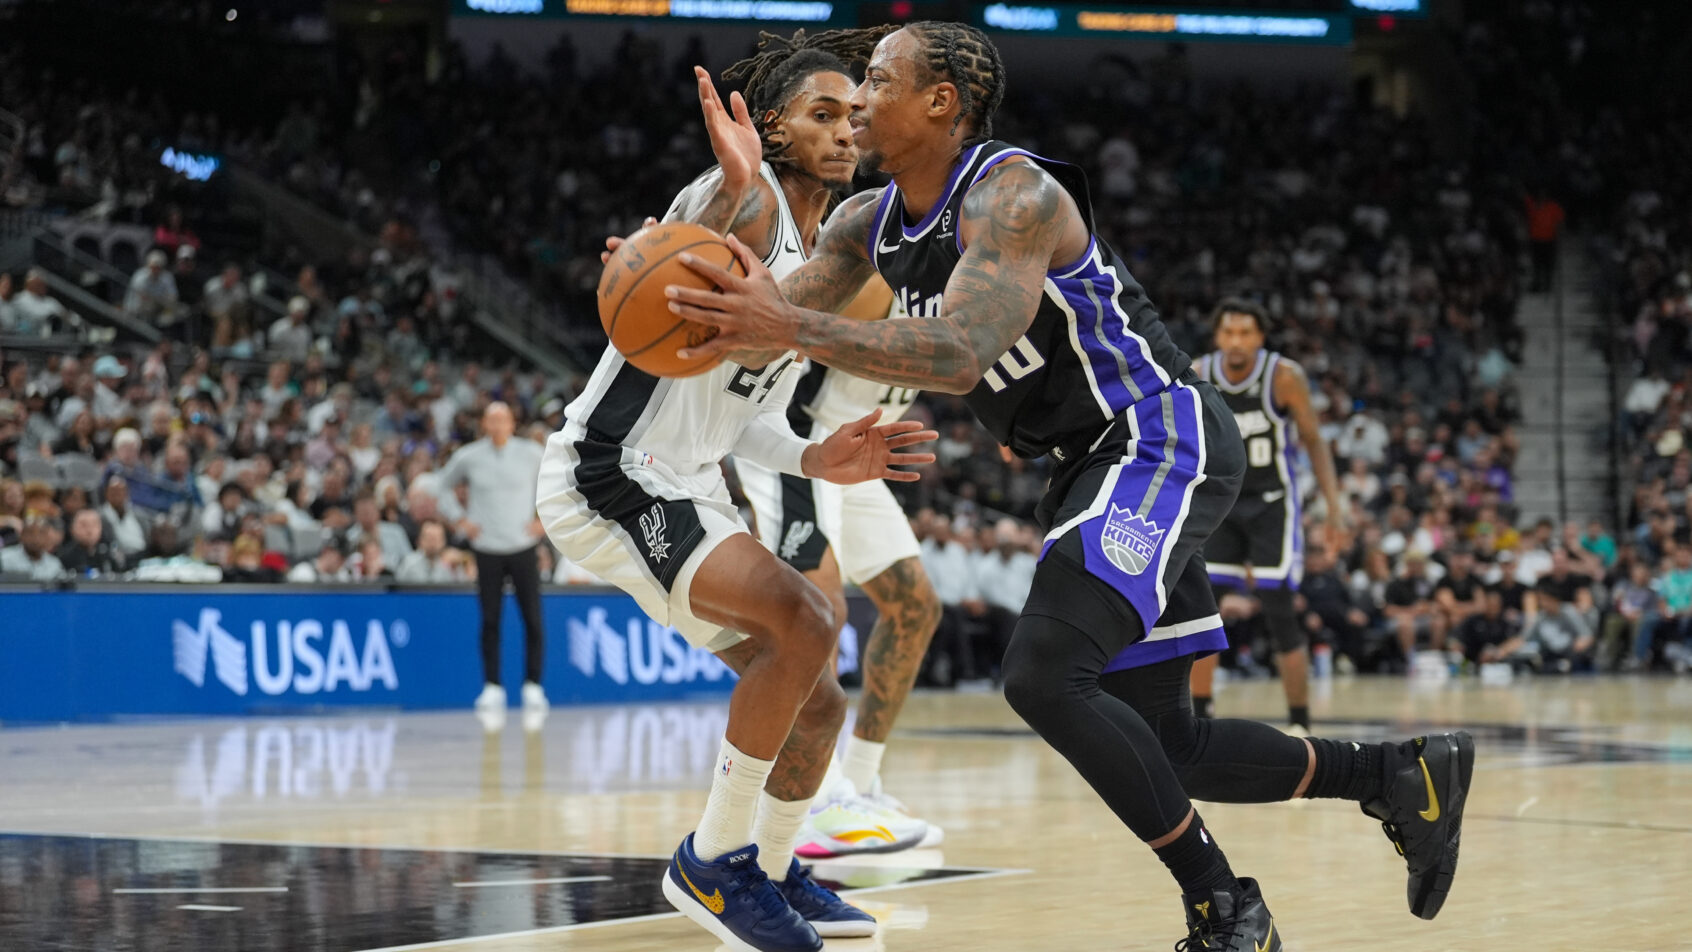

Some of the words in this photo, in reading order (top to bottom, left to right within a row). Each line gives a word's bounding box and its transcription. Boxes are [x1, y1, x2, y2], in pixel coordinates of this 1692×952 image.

[1104, 526, 1154, 562] KINGS
[1110, 519, 1156, 550] SACRAMENTO
[251, 618, 399, 695] USAA
[627, 617, 738, 684] USA
